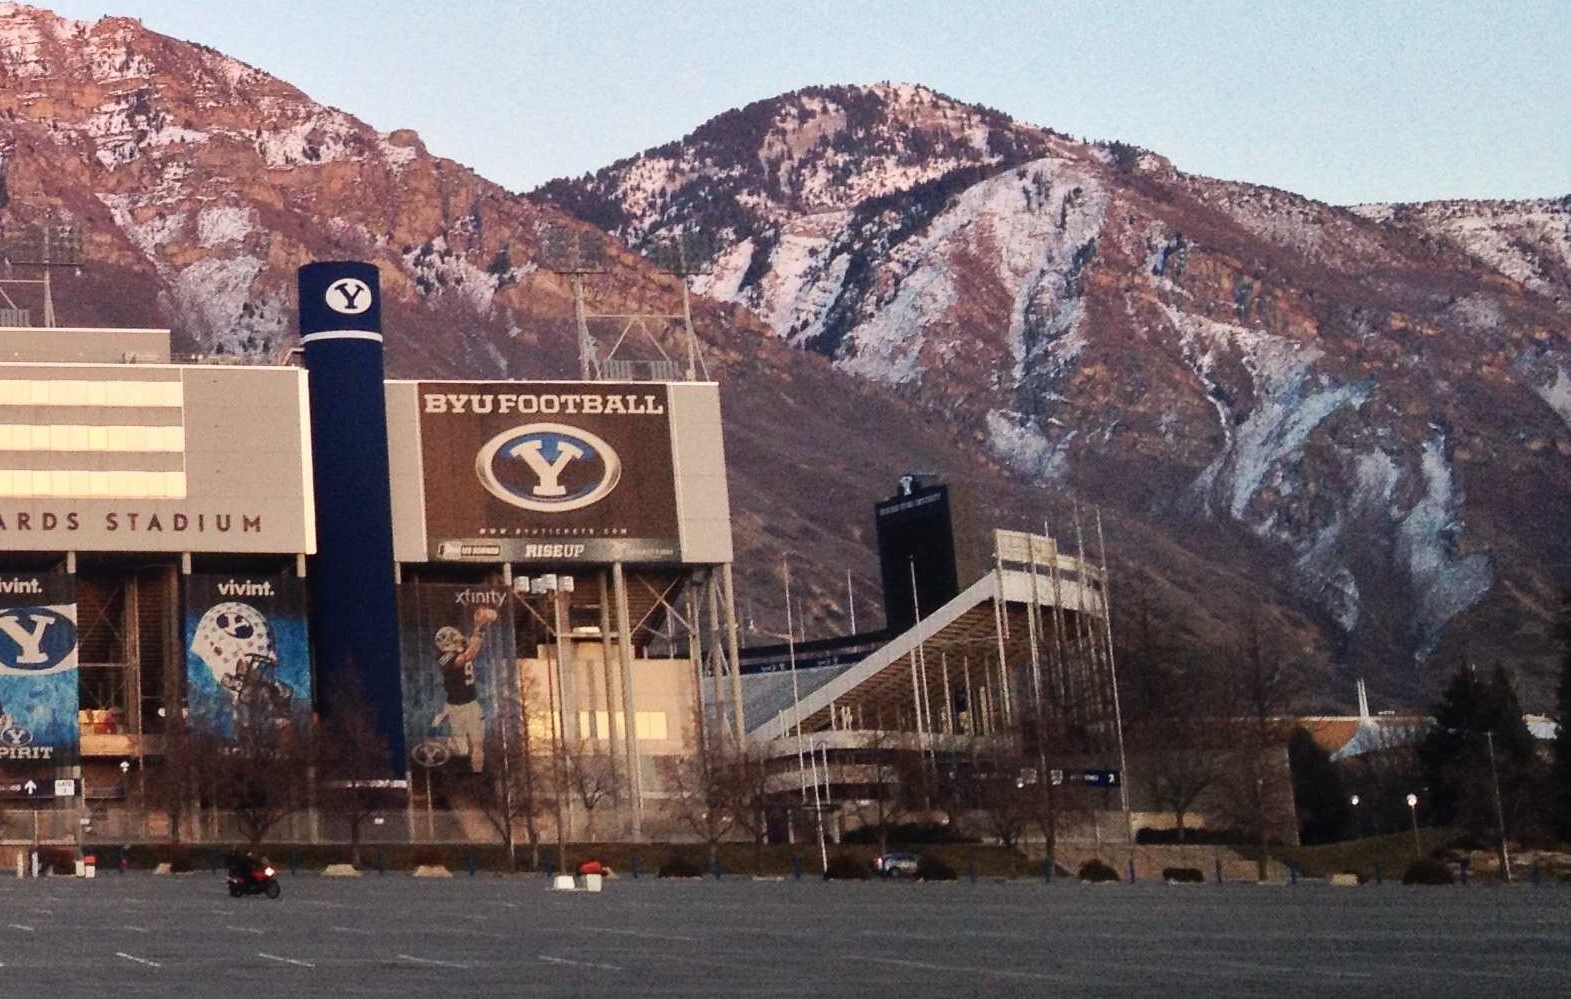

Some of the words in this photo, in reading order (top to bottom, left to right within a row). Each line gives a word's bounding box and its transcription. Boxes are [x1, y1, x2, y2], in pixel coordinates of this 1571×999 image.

[333, 282, 365, 309] Y
[424, 393, 494, 414] BYU
[498, 394, 664, 415] FOOTBALL
[509, 439, 585, 496] Y
[105, 512, 262, 533] STADIUM
[455, 588, 508, 606] xfinity
[7, 728, 26, 744] Y
